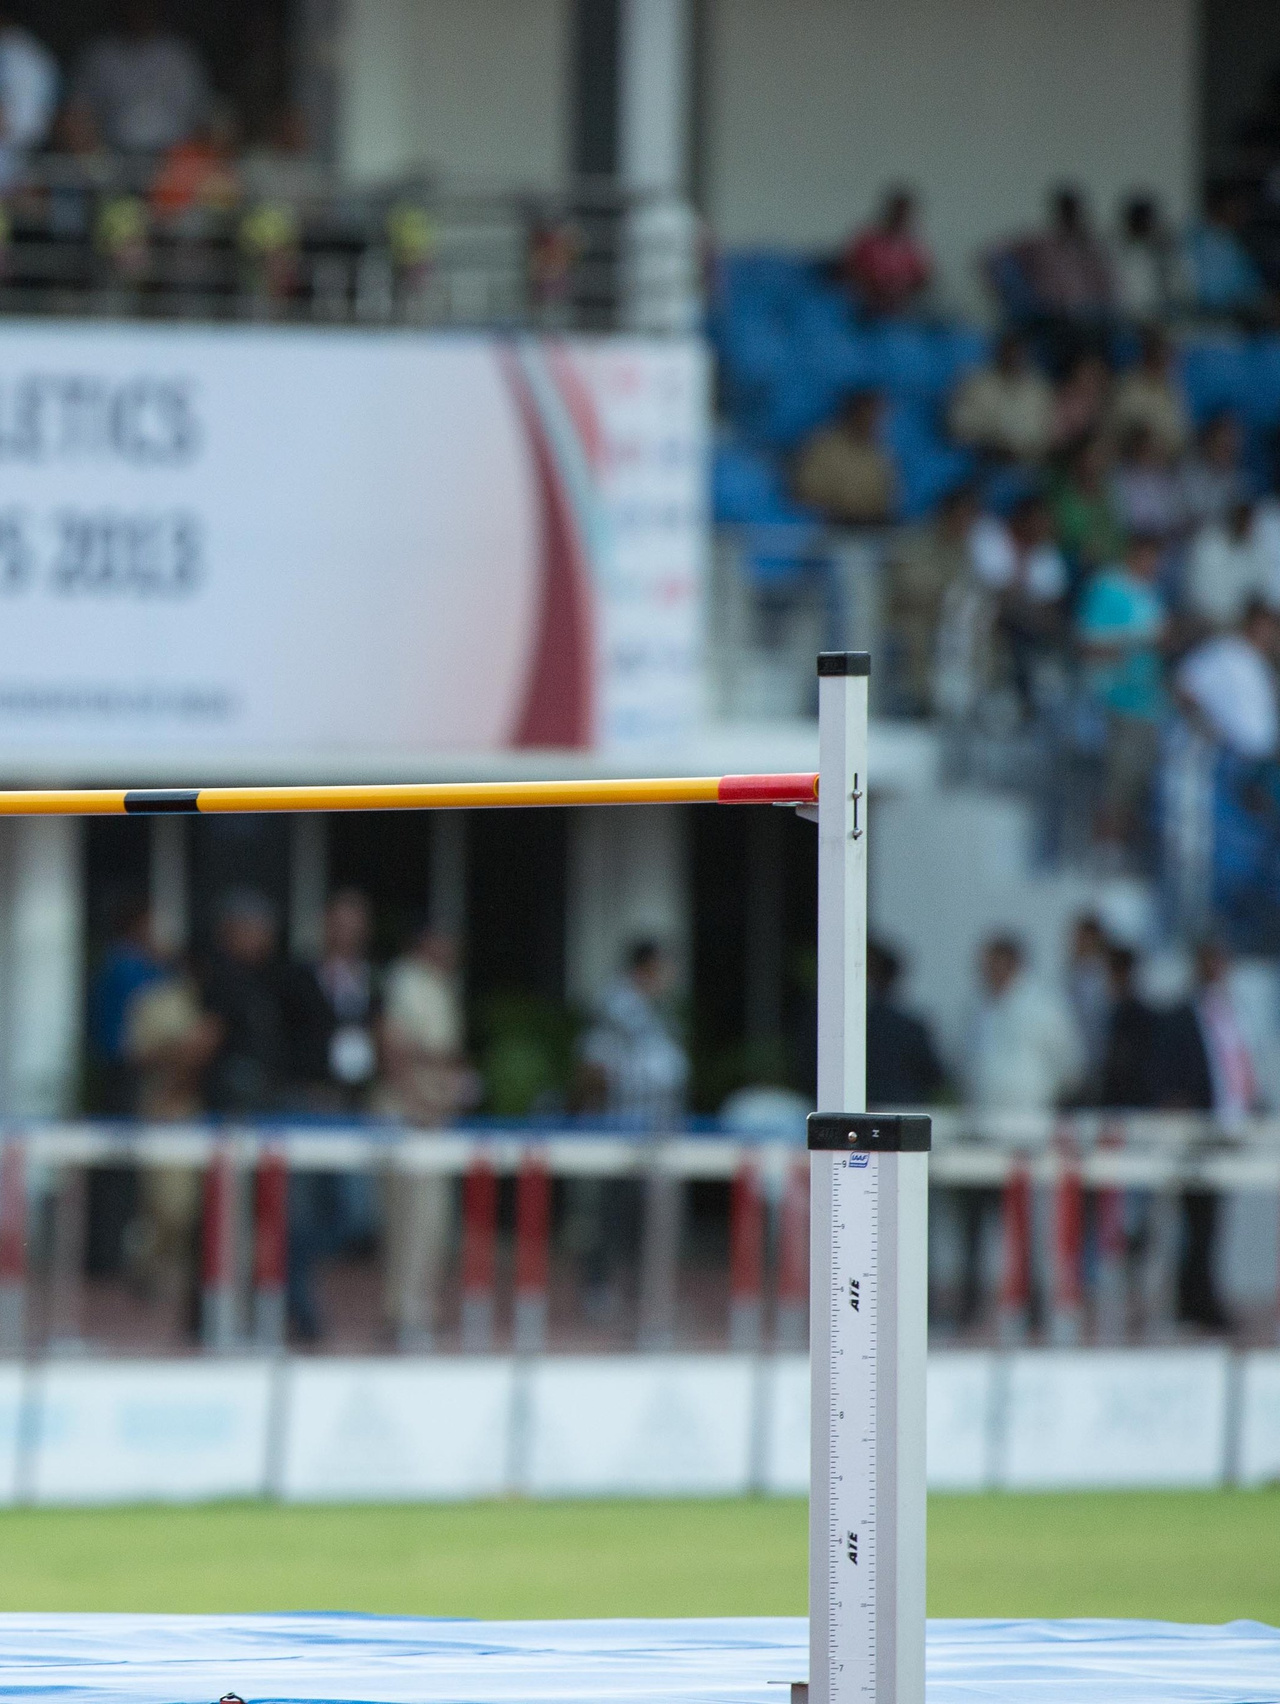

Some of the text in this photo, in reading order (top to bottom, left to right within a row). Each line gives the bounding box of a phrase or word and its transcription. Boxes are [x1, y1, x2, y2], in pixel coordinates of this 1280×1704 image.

[52, 512, 206, 596] 2013
[842, 1160, 847, 1168] 9
[849, 1277, 860, 1313] ATE
[839, 1411, 844, 1419] 8
[847, 1530, 858, 1566] ATE
